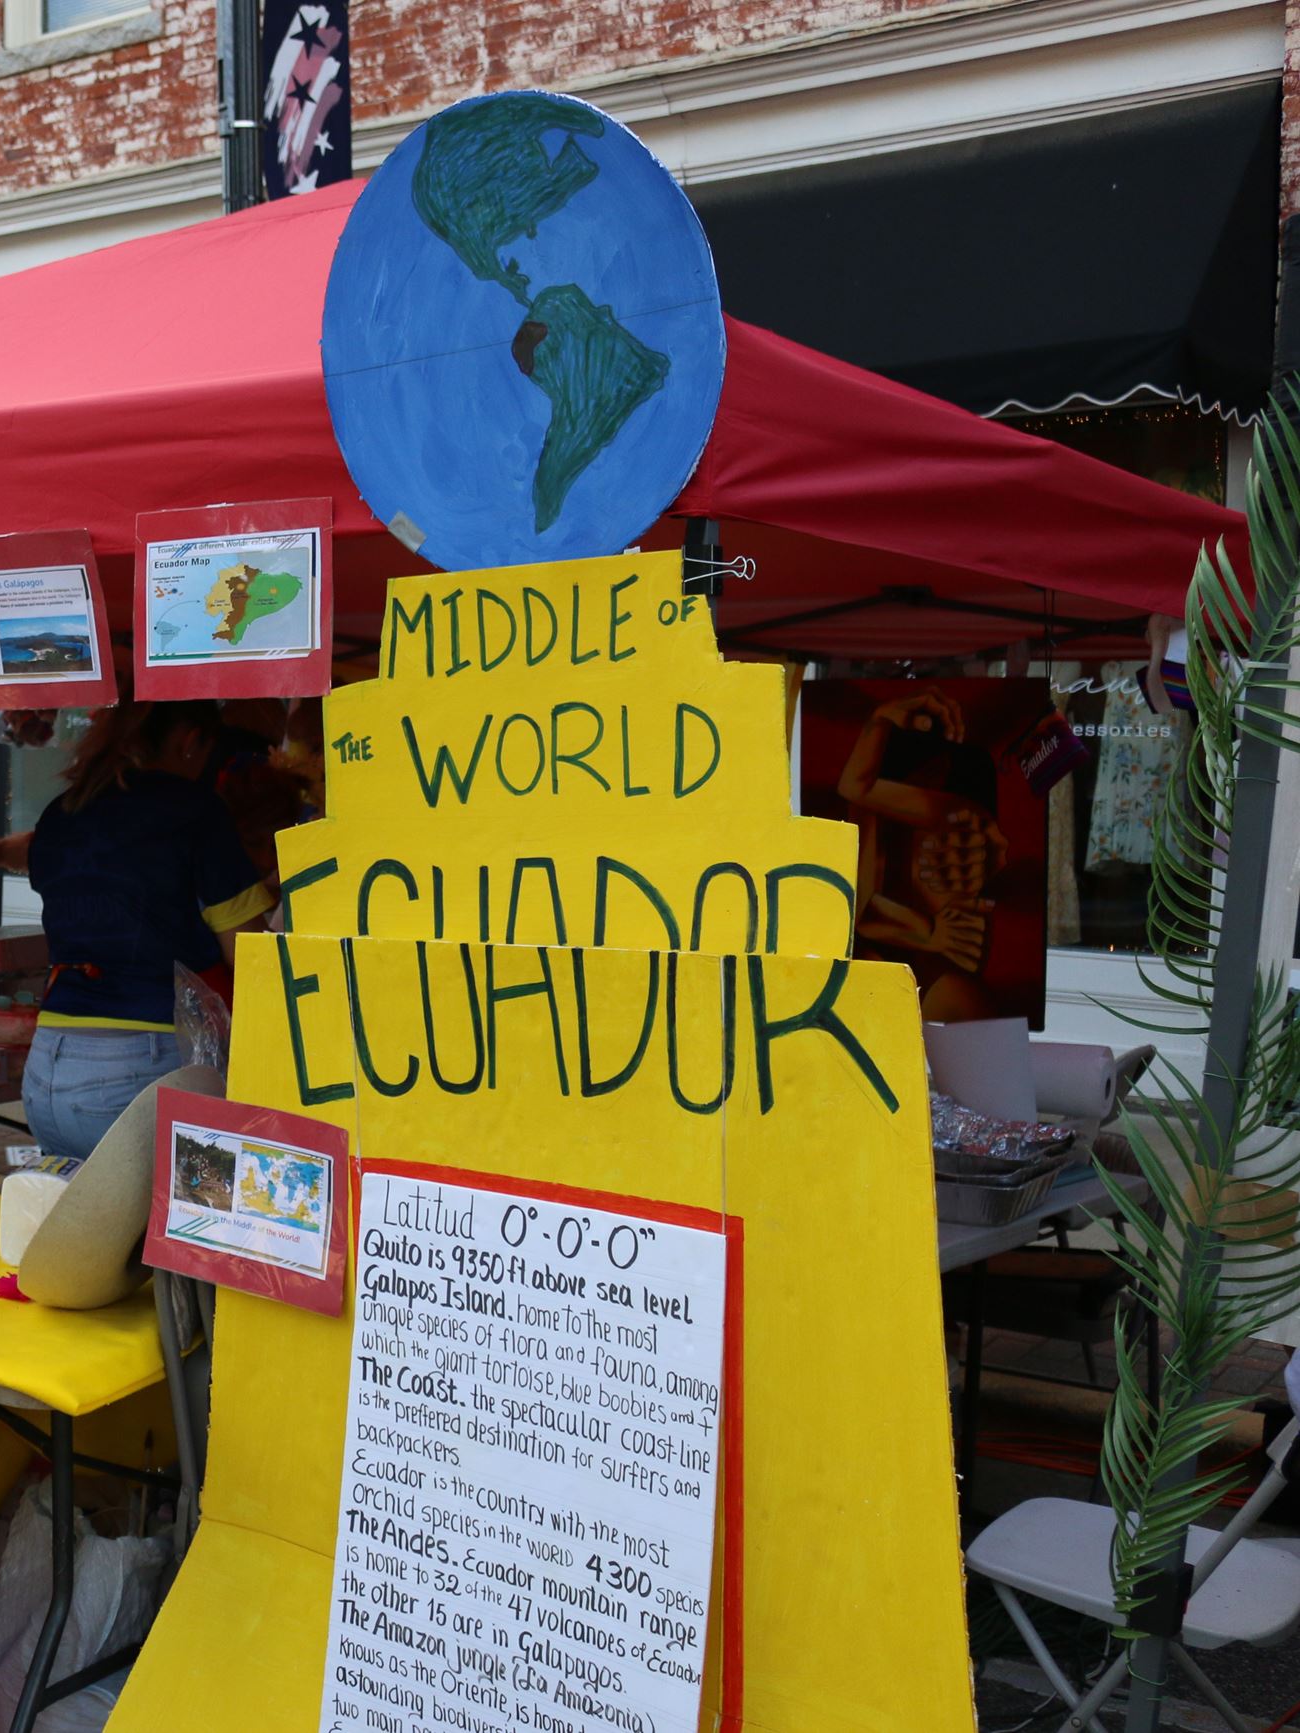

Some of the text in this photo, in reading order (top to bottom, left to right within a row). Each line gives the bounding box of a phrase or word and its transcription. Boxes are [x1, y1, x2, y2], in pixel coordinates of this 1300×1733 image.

[154, 556, 211, 569] Ecuador Map
[199, 540, 225, 550] different
[387, 574, 699, 679] MIDDLE OF
[331, 701, 721, 808] THE WORLD
[1070, 720, 1172, 738] essories
[277, 856, 900, 1116] ECUADOR
[233, 1218, 256, 1232] Middle
[266, 1227, 277, 1238] the
[383, 1179, 476, 1241] Latitud
[361, 1263, 437, 1309] Galapos
[517, 1293, 560, 1333] home
[561, 1304, 582, 1336] to
[580, 1308, 612, 1343] the
[617, 1323, 658, 1355] most
[364, 1228, 422, 1267] Quito
[428, 1242, 446, 1271] is
[451, 1244, 505, 1285] 9350
[531, 1263, 586, 1299] above
[596, 1281, 634, 1309] sea
[643, 1286, 694, 1325] level
[361, 1329, 406, 1359] which
[411, 1339, 429, 1361] the
[428, 1345, 478, 1380] giant
[481, 1353, 559, 1401] tortoise,
[561, 1373, 592, 1405] blue
[598, 1382, 667, 1425] boobies
[670, 1410, 695, 1425] and
[362, 1300, 719, 1417] unique species of flora and fauna, among
[357, 1355, 711, 1474] The Coast. the spectacular coast-line
[357, 1416, 462, 1468] backpackers.
[358, 1387, 701, 1500] is the preffered destination for surfers and
[351, 1448, 670, 1569] Ecuador is the country with the most
[352, 1483, 415, 1521] orchid
[421, 1505, 481, 1538] species
[484, 1520, 496, 1539] in
[499, 1524, 522, 1548] the
[585, 1553, 653, 1598] 4300
[655, 1586, 705, 1617] species
[345, 1508, 699, 1652] The Andes. Ecuador mountain range
[345, 1540, 702, 1686] is home to 32 of the 47 volcanoes of Ecuador
[338, 1599, 370, 1632] The
[372, 1611, 447, 1659] Amazon
[447, 1638, 507, 1684] jungle
[341, 1569, 627, 1694] the other 15 are in Galapagos.
[332, 1692, 360, 1720] two
[366, 1708, 404, 1733] main
[336, 1665, 424, 1720] astounding
[388, 1656, 408, 1678] as
[410, 1658, 436, 1688] the
[440, 1669, 513, 1722] Oriente,
[515, 1696, 530, 1725] is
